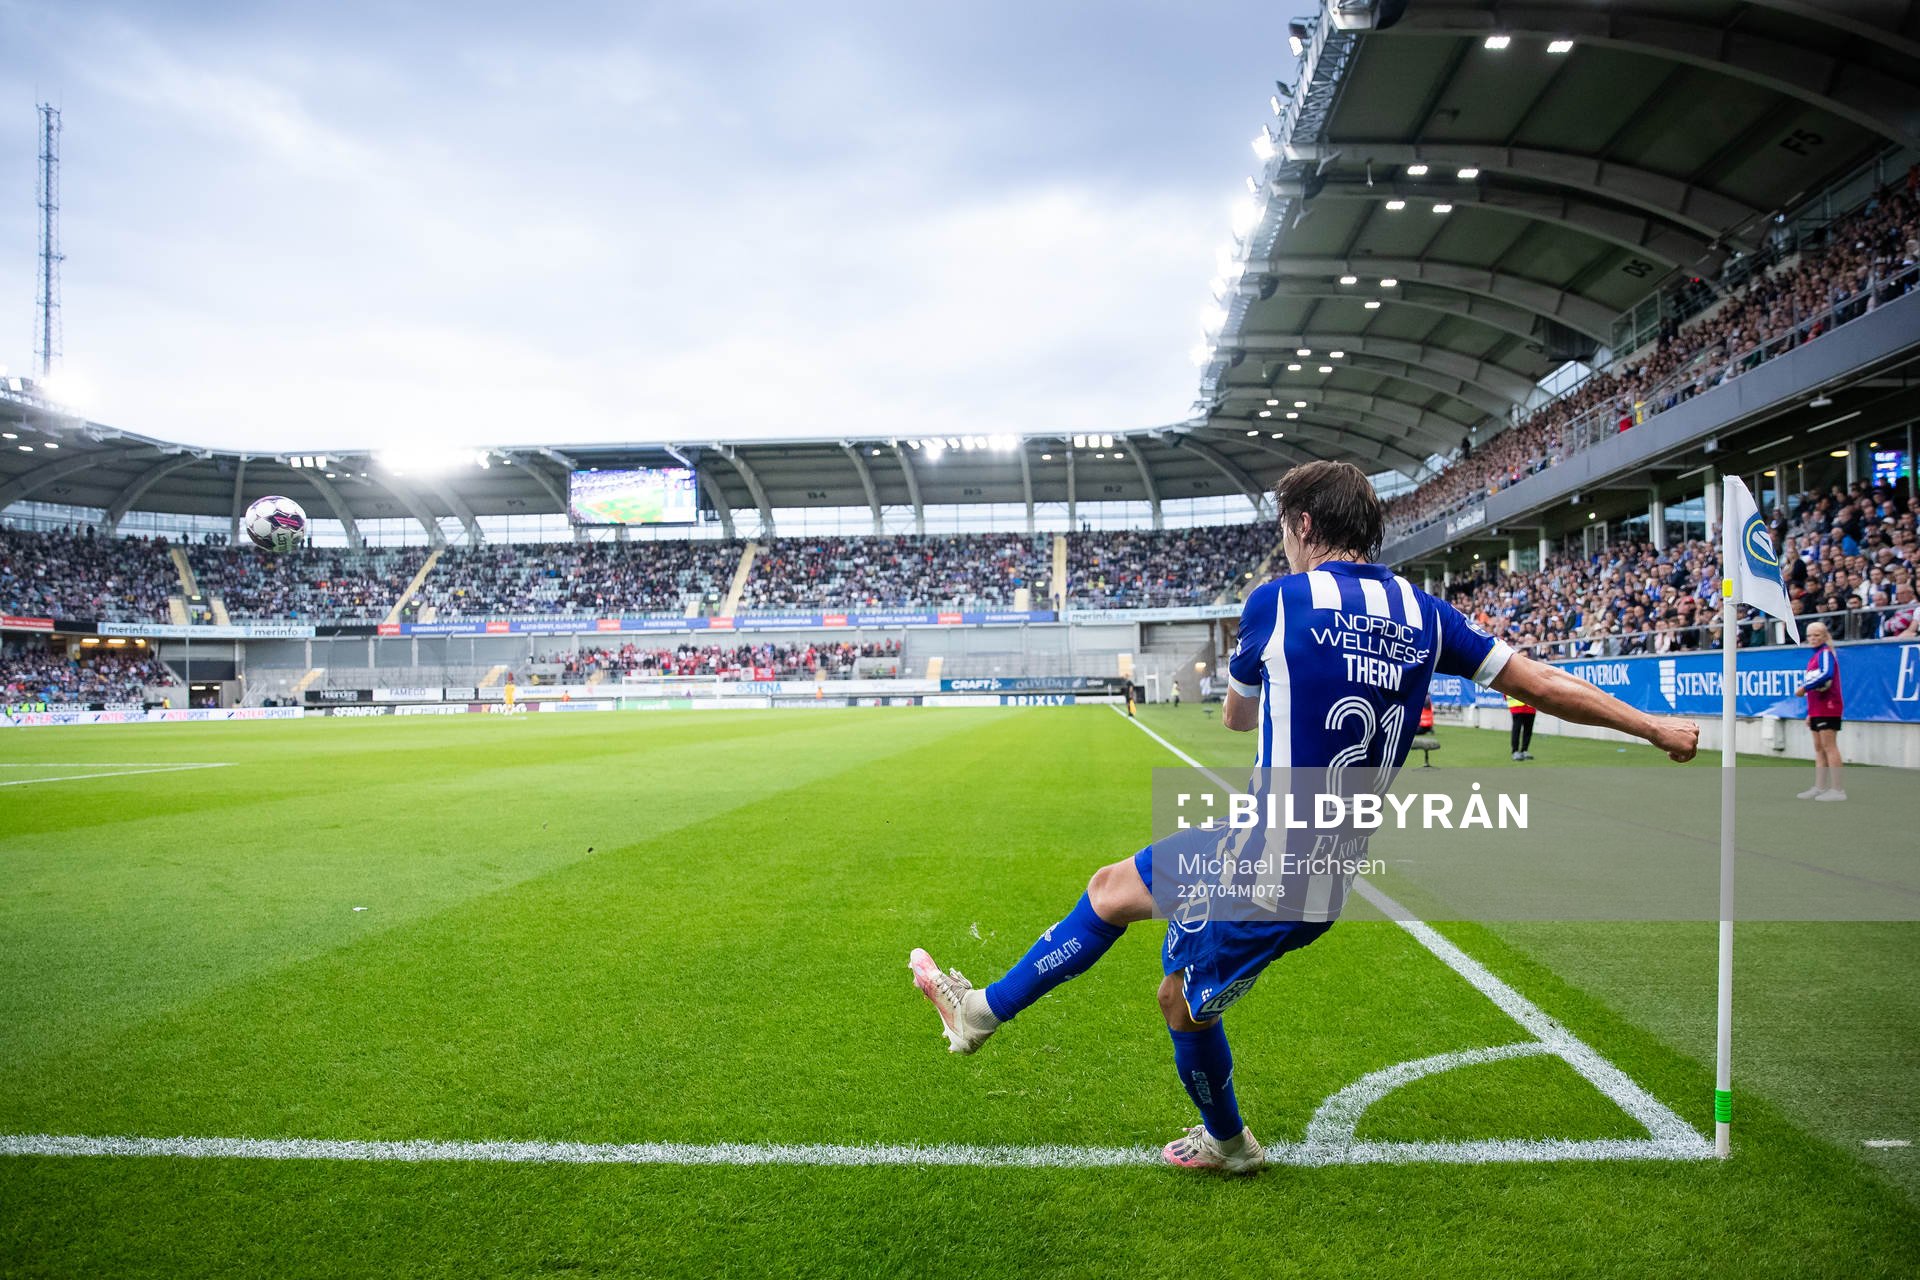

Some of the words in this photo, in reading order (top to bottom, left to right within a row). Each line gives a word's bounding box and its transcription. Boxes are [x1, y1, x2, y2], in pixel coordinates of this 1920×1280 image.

[1334, 611, 1414, 643] NORDIC
[1310, 627, 1430, 664] WELLNESS
[748, 682, 783, 695] STENA
[951, 679, 991, 691] CRAFT
[1342, 653, 1403, 692] THERN
[1676, 670, 1807, 697] STENFATIGHETE
[1006, 695, 1066, 707] BRIXLY
[1325, 695, 1405, 816] 21
[1033, 937, 1082, 976] SILFVERLOK
